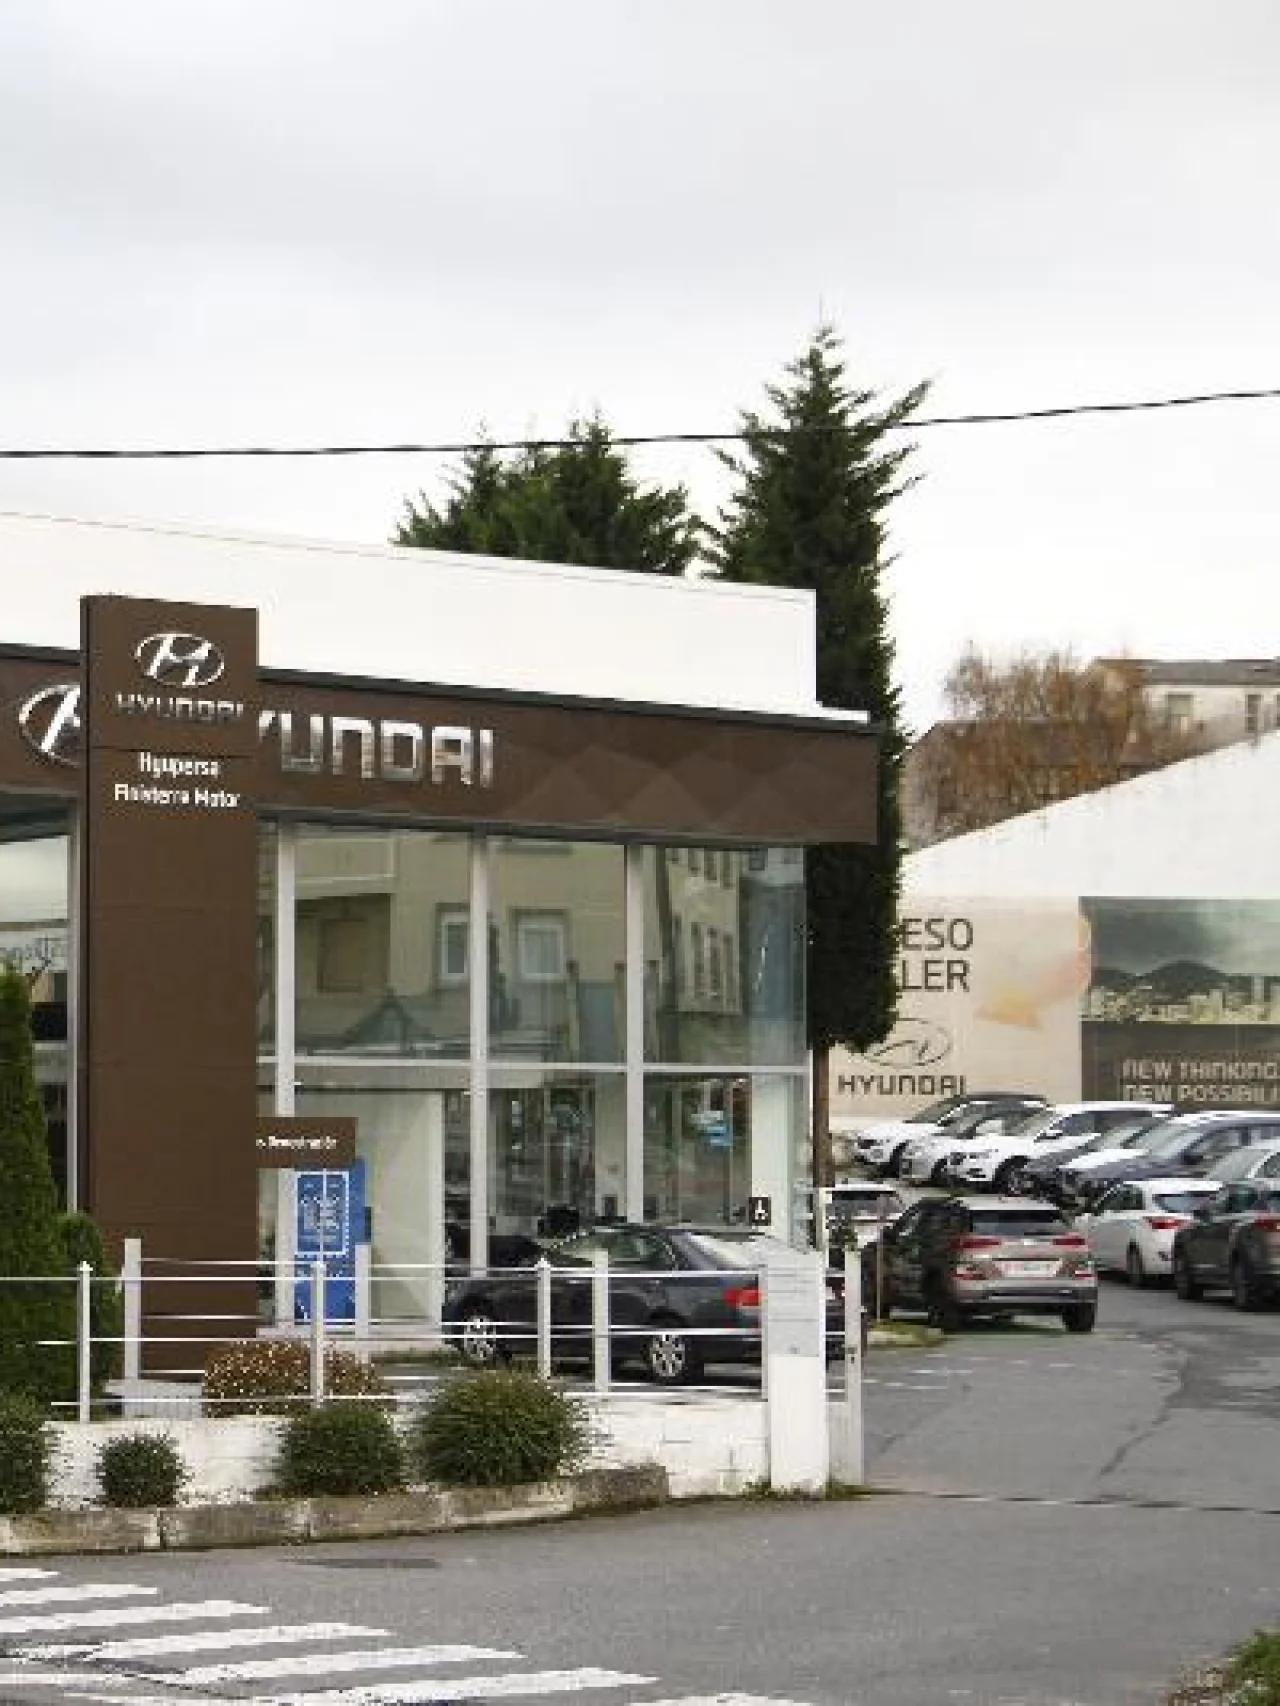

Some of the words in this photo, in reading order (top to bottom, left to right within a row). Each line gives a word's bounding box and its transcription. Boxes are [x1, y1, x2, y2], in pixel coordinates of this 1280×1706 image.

[115, 694, 244, 721] HYUNDAI
[258, 710, 494, 788] UNDAI
[139, 752, 219, 778] Hyupersa
[901, 918, 973, 951] ESO
[902, 960, 970, 992] LER
[838, 1075, 966, 1096] HYUNDAI
